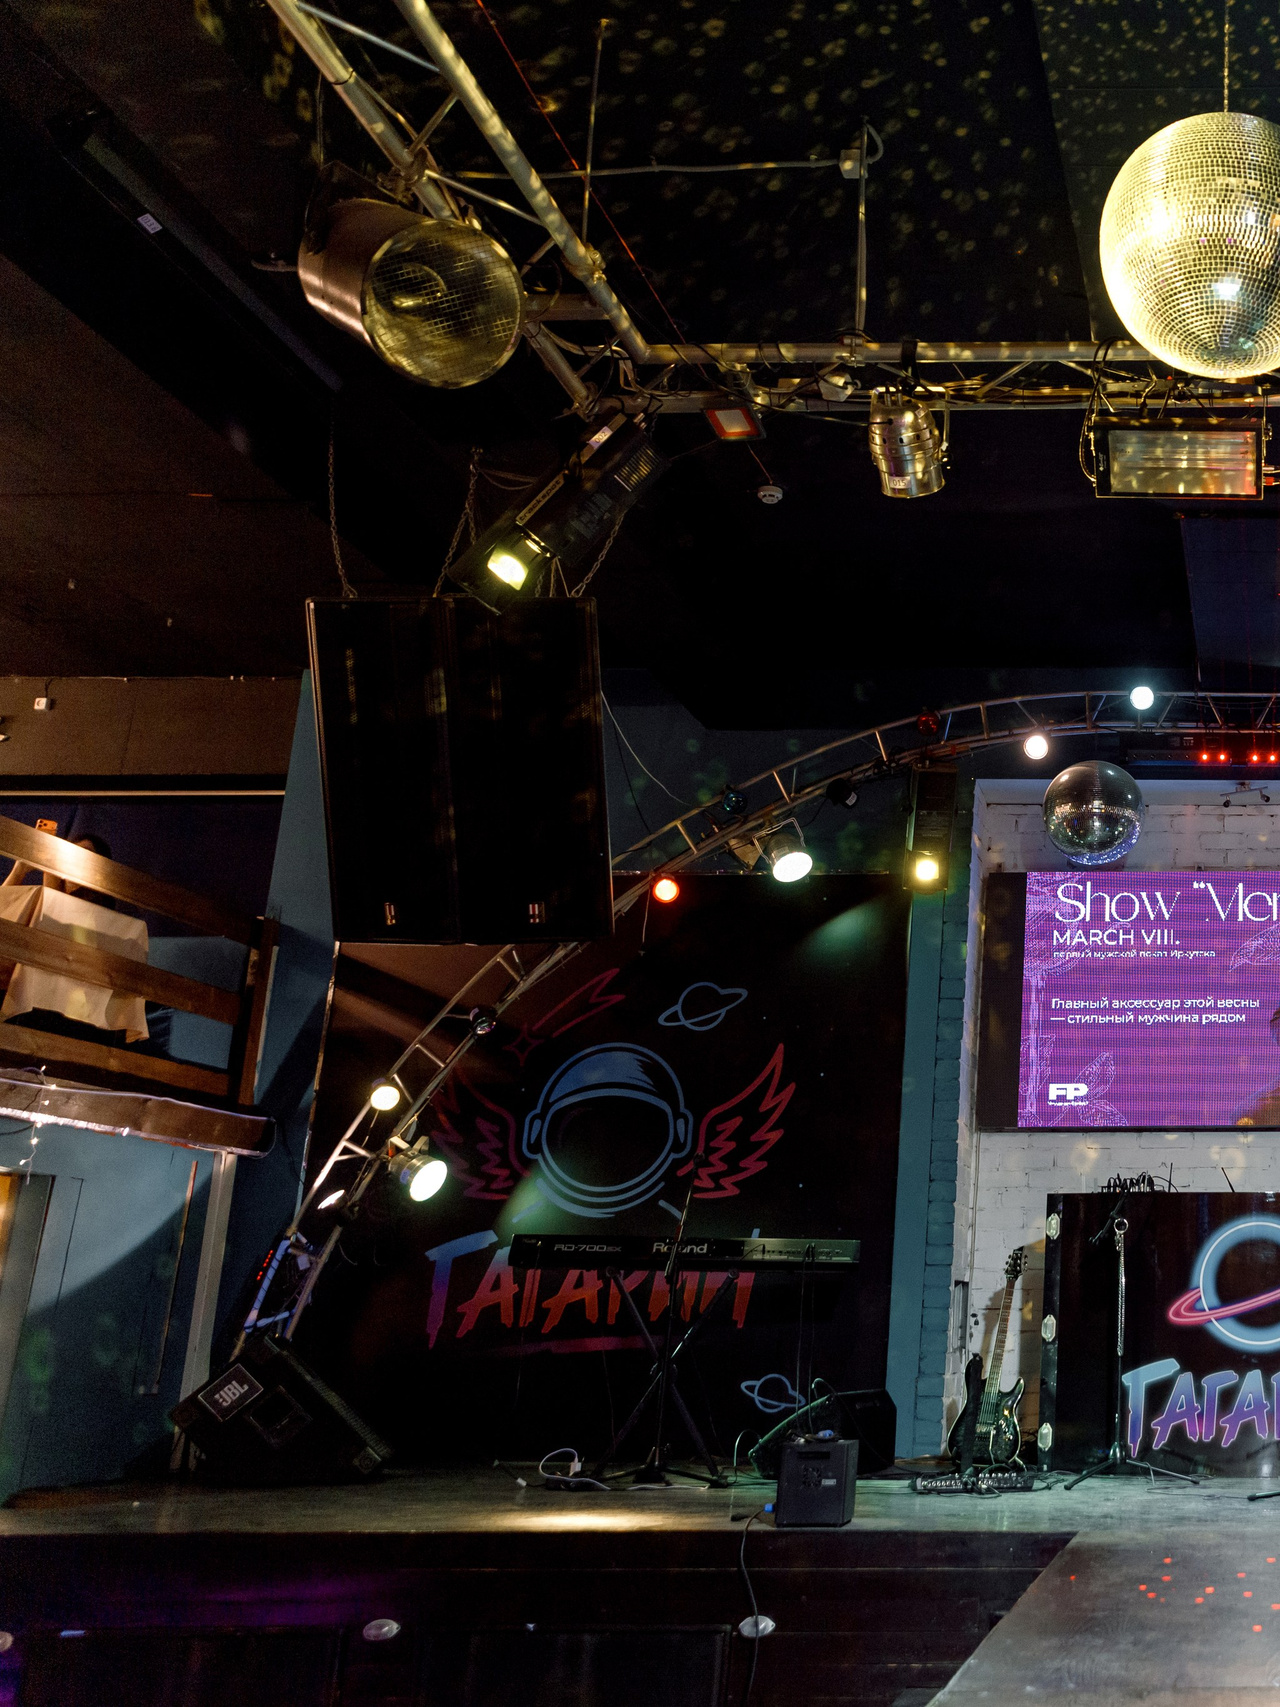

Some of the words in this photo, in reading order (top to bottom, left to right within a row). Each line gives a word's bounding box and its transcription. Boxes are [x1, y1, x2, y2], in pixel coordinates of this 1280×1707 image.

[892, 479, 907, 487] 015
[518, 479, 562, 523] trackspot
[1055, 881, 1181, 922] Show
[1052, 929, 1135, 946] MARCH
[1141, 929, 1181, 945] VIII.
[1051, 997, 1109, 1009] Главный
[1112, 999, 1181, 1011] аксессуар
[1183, 996, 1215, 1009] этой
[1217, 998, 1260, 1009] весны
[1067, 1012, 1134, 1024] стильный
[1138, 1013, 1199, 1025] мужчина
[1201, 1013, 1246, 1025] рядом
[215, 1380, 250, 1407] JBL
